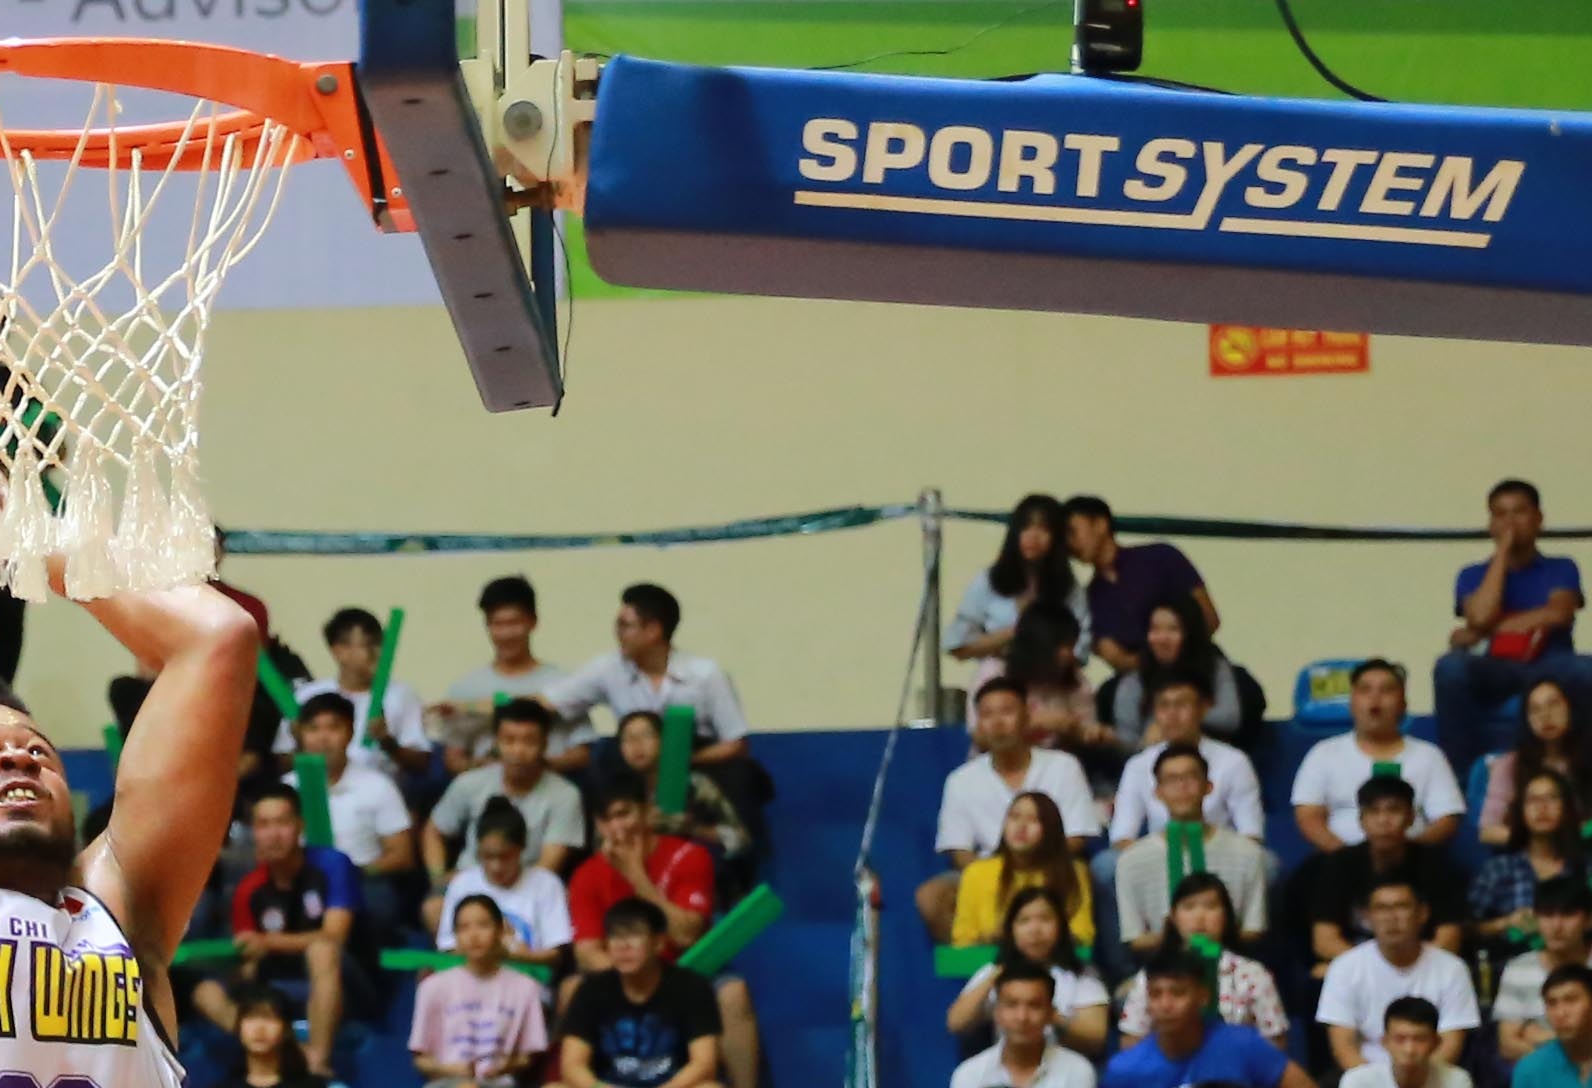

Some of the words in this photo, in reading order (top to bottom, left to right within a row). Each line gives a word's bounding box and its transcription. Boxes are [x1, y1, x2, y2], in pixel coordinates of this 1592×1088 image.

[799, 118, 1120, 198] SPORT
[1122, 138, 1526, 229] SYSTEM
[10, 916, 48, 939] CHI
[30, 940, 143, 1047] WINGS
